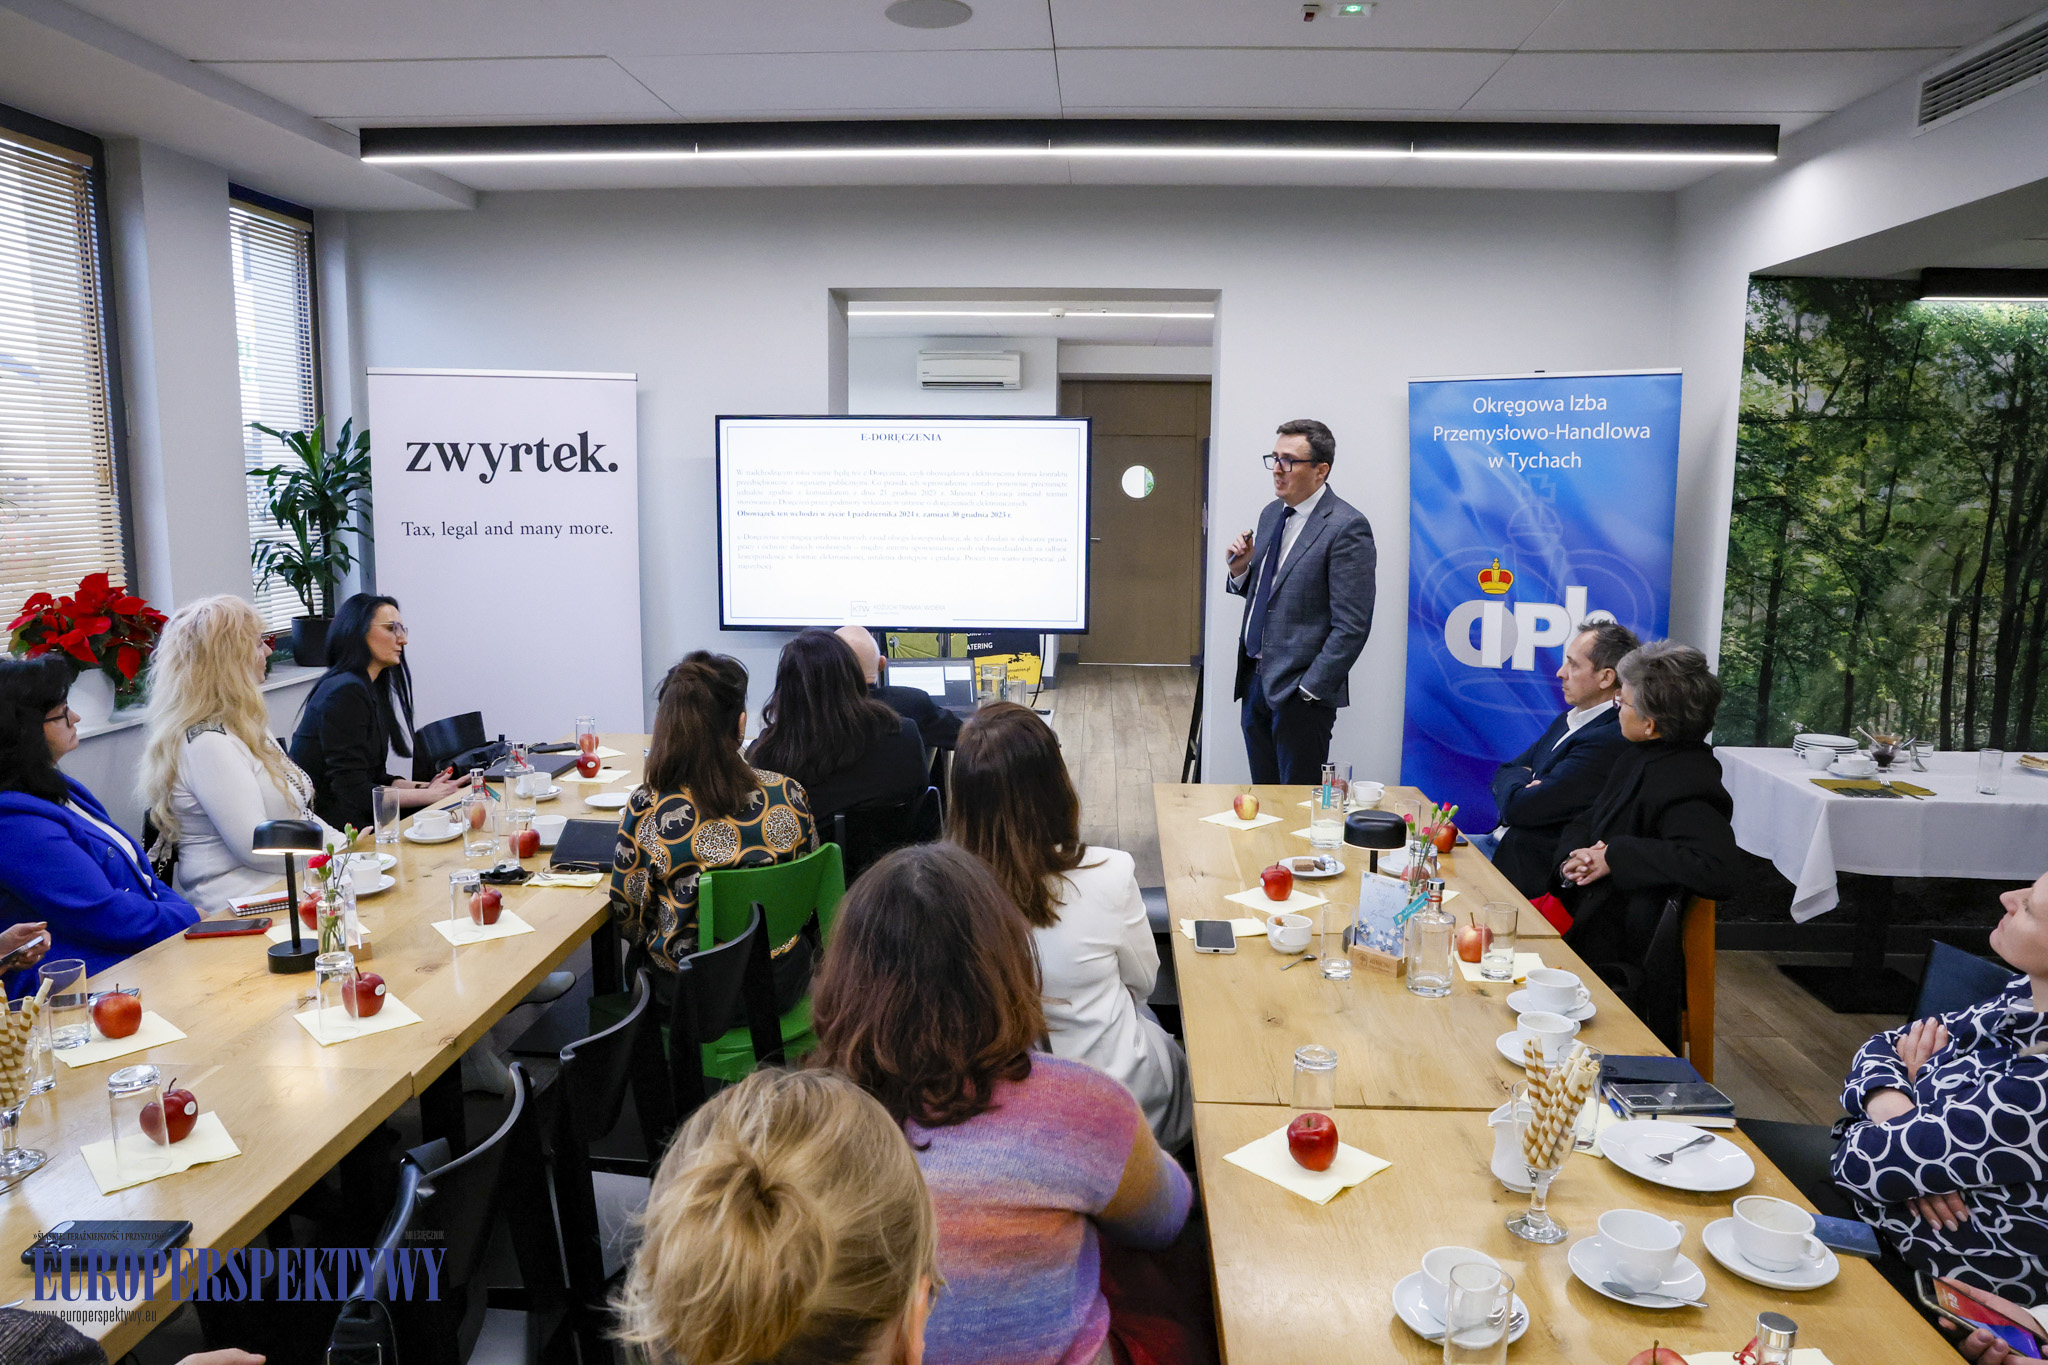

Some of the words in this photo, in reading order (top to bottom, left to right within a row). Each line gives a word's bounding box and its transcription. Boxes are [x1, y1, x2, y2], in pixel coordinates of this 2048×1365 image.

[1473, 396, 1564, 416] Okręgowa
[1570, 394, 1607, 411] Izba
[1434, 422, 1650, 445] Przemysłowo-Handlowa
[405, 430, 618, 484] zwyrtek.
[1488, 456, 1503, 468] w
[1508, 452, 1582, 472] Tychach
[402, 521, 436, 538] Tax,
[442, 521, 478, 540] legal
[484, 521, 514, 536] and
[520, 524, 562, 539] many
[569, 524, 614, 535] more.
[966, 642, 994, 650] ATERING
